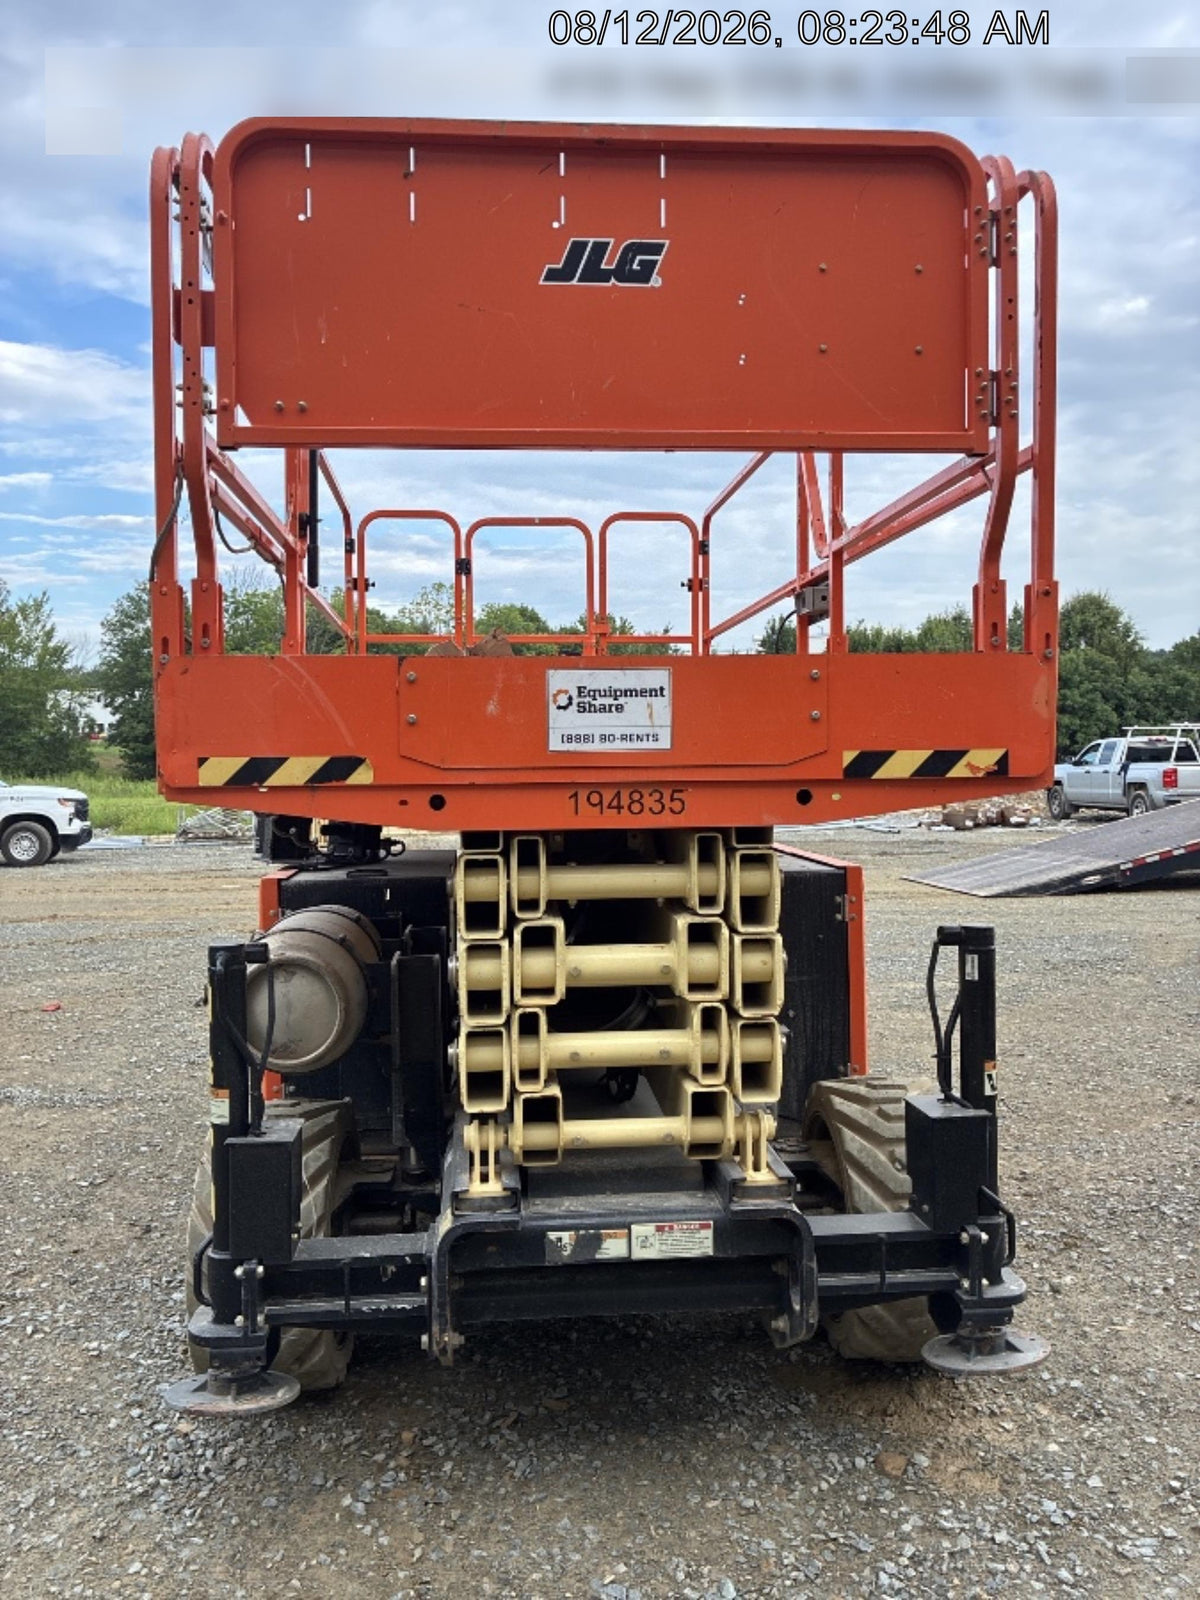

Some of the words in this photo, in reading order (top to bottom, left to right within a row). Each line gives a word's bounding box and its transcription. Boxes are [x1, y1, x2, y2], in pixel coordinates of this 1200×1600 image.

[540, 238, 669, 286] JLG
[576, 686, 666, 701] Equipment
[576, 701, 625, 714] Share
[599, 733, 659, 744] 80-RENTS
[568, 789, 686, 816] 194835
